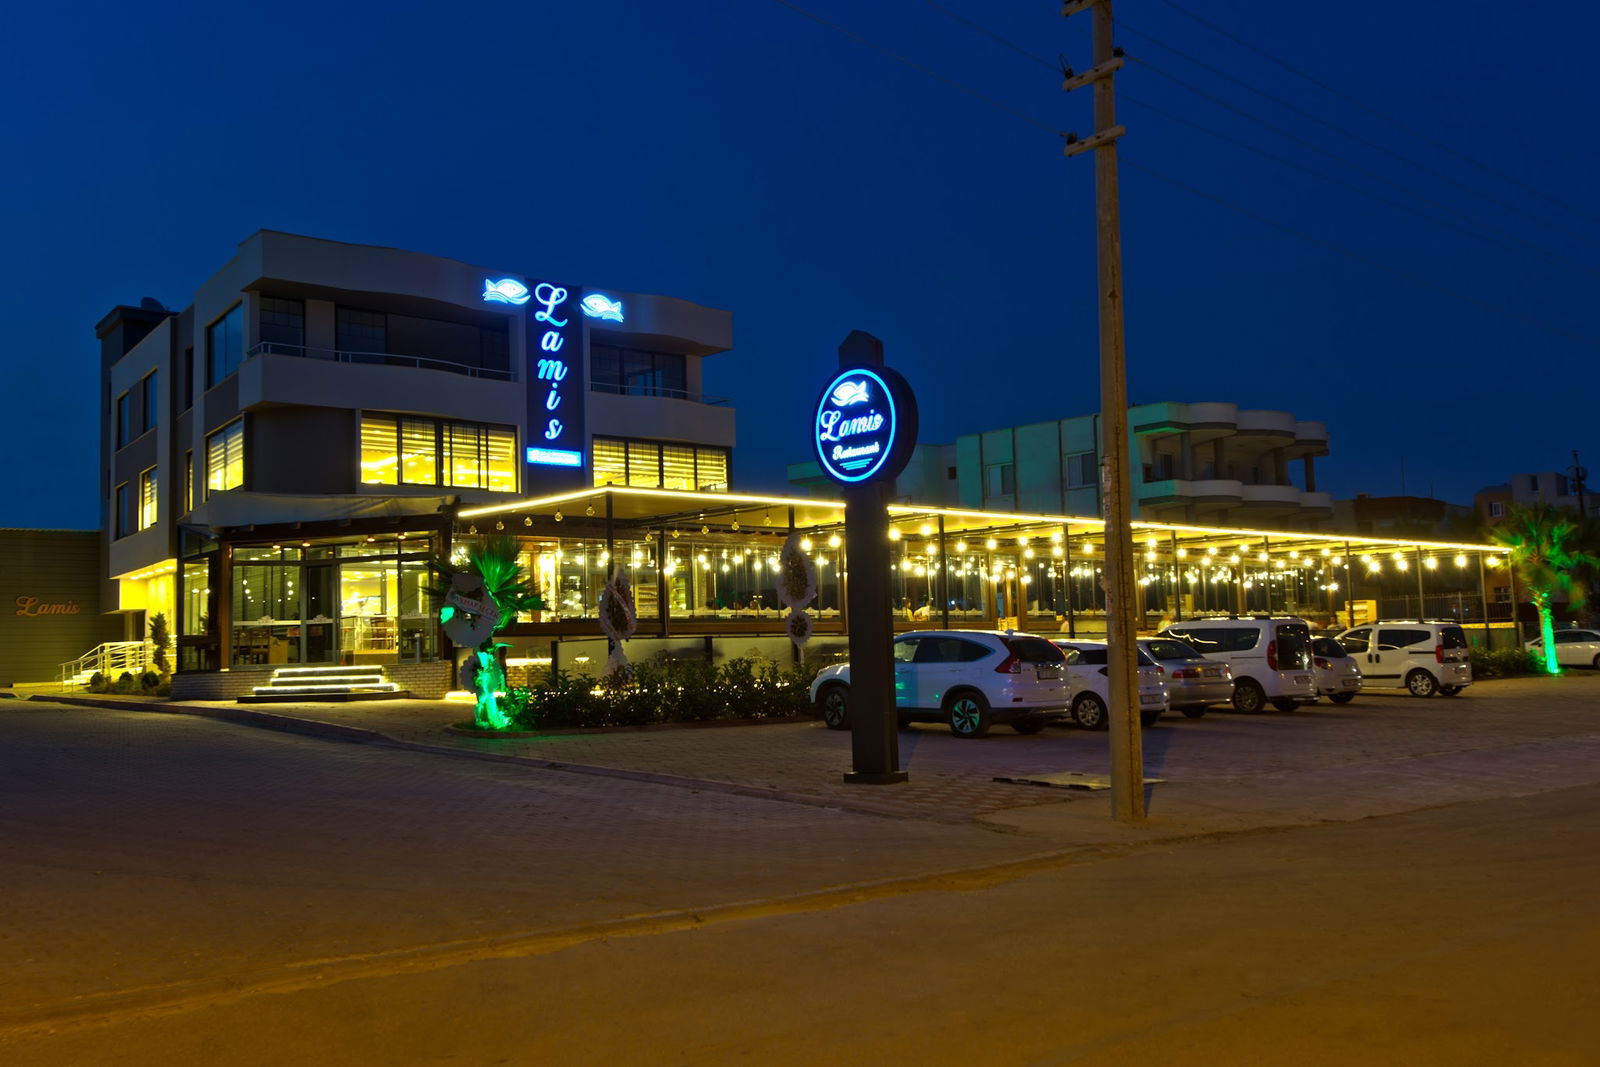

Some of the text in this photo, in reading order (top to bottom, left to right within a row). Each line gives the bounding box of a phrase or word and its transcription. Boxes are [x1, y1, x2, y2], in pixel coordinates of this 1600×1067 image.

[535, 283, 568, 440] Lamis
[820, 409, 883, 441] Lamis
[15, 595, 80, 616] Lamis
